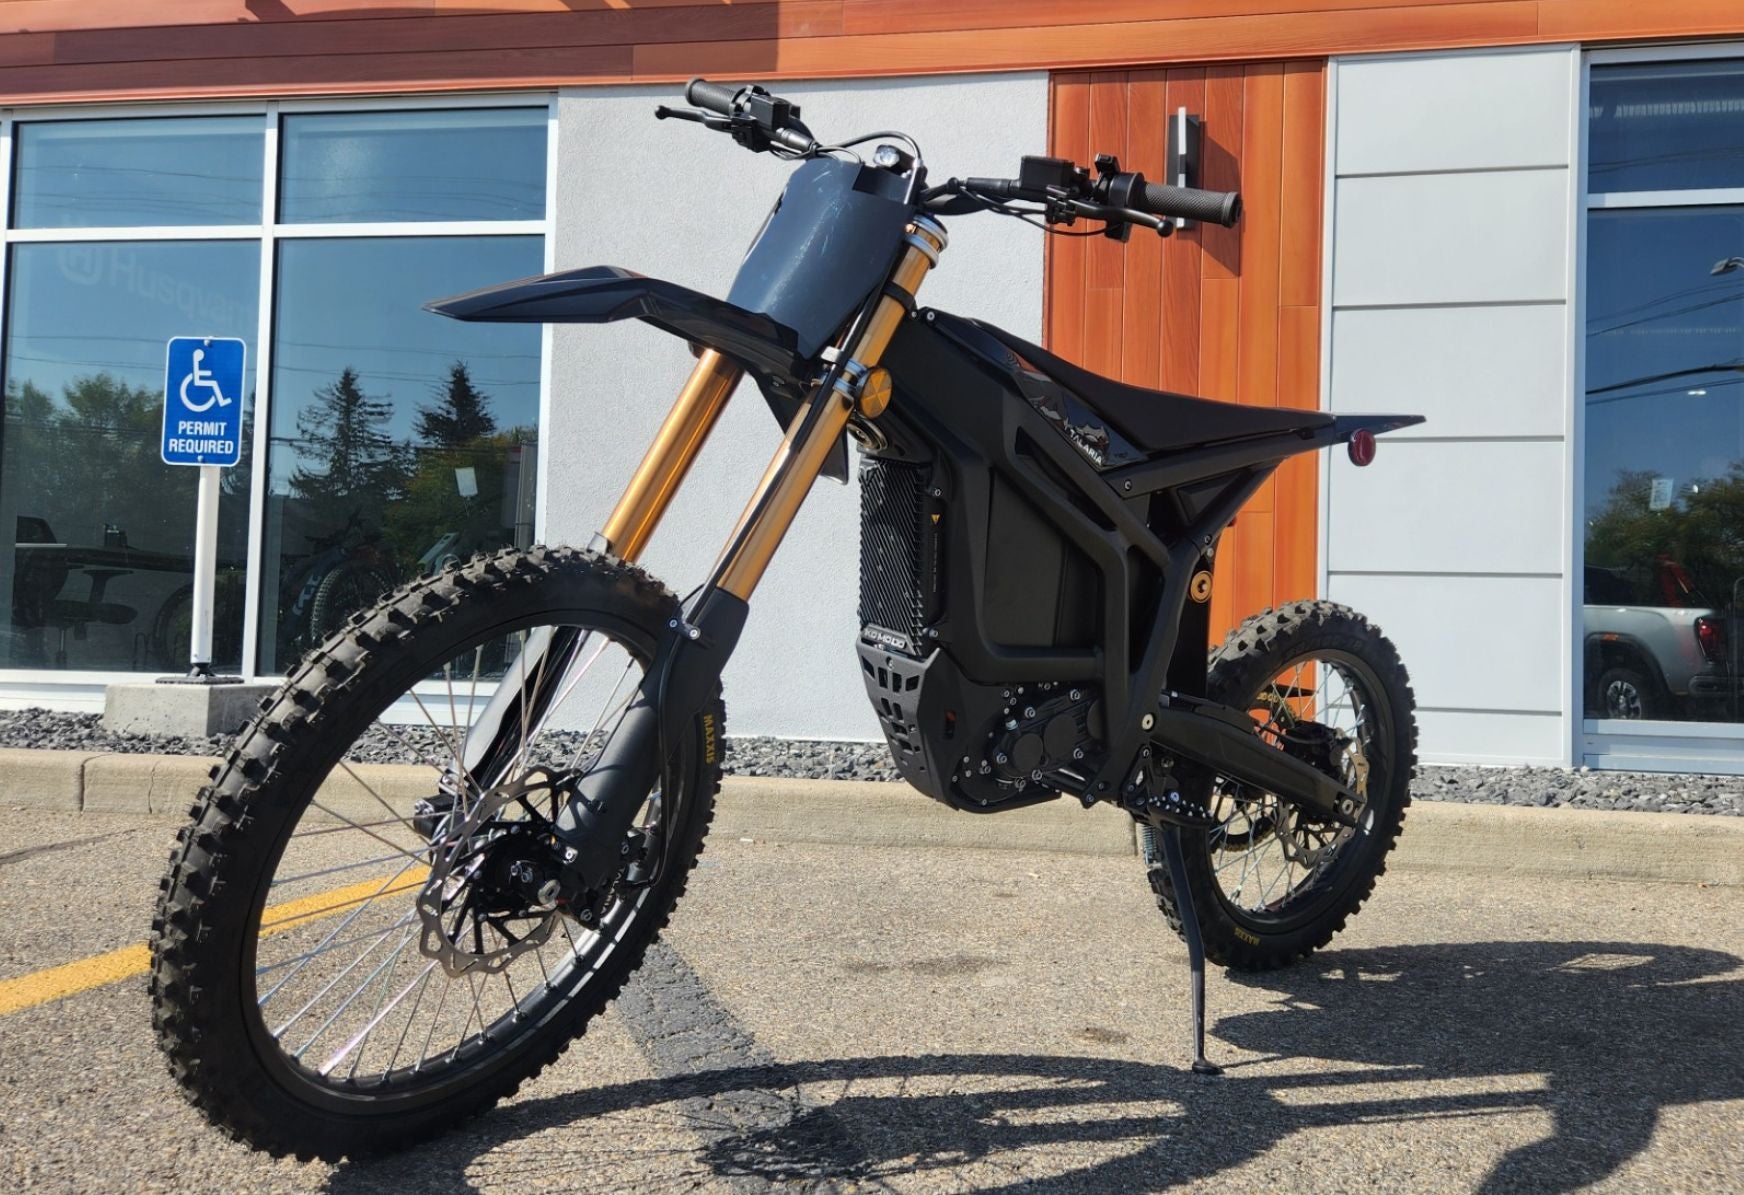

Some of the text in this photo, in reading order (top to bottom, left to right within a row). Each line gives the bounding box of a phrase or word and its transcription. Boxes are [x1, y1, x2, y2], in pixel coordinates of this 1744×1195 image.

[178, 420, 228, 437] PERMIT
[168, 438, 234, 455] REQUIRED
[1069, 429, 1103, 466] TALARIA
[863, 628, 907, 649] KOMODO
